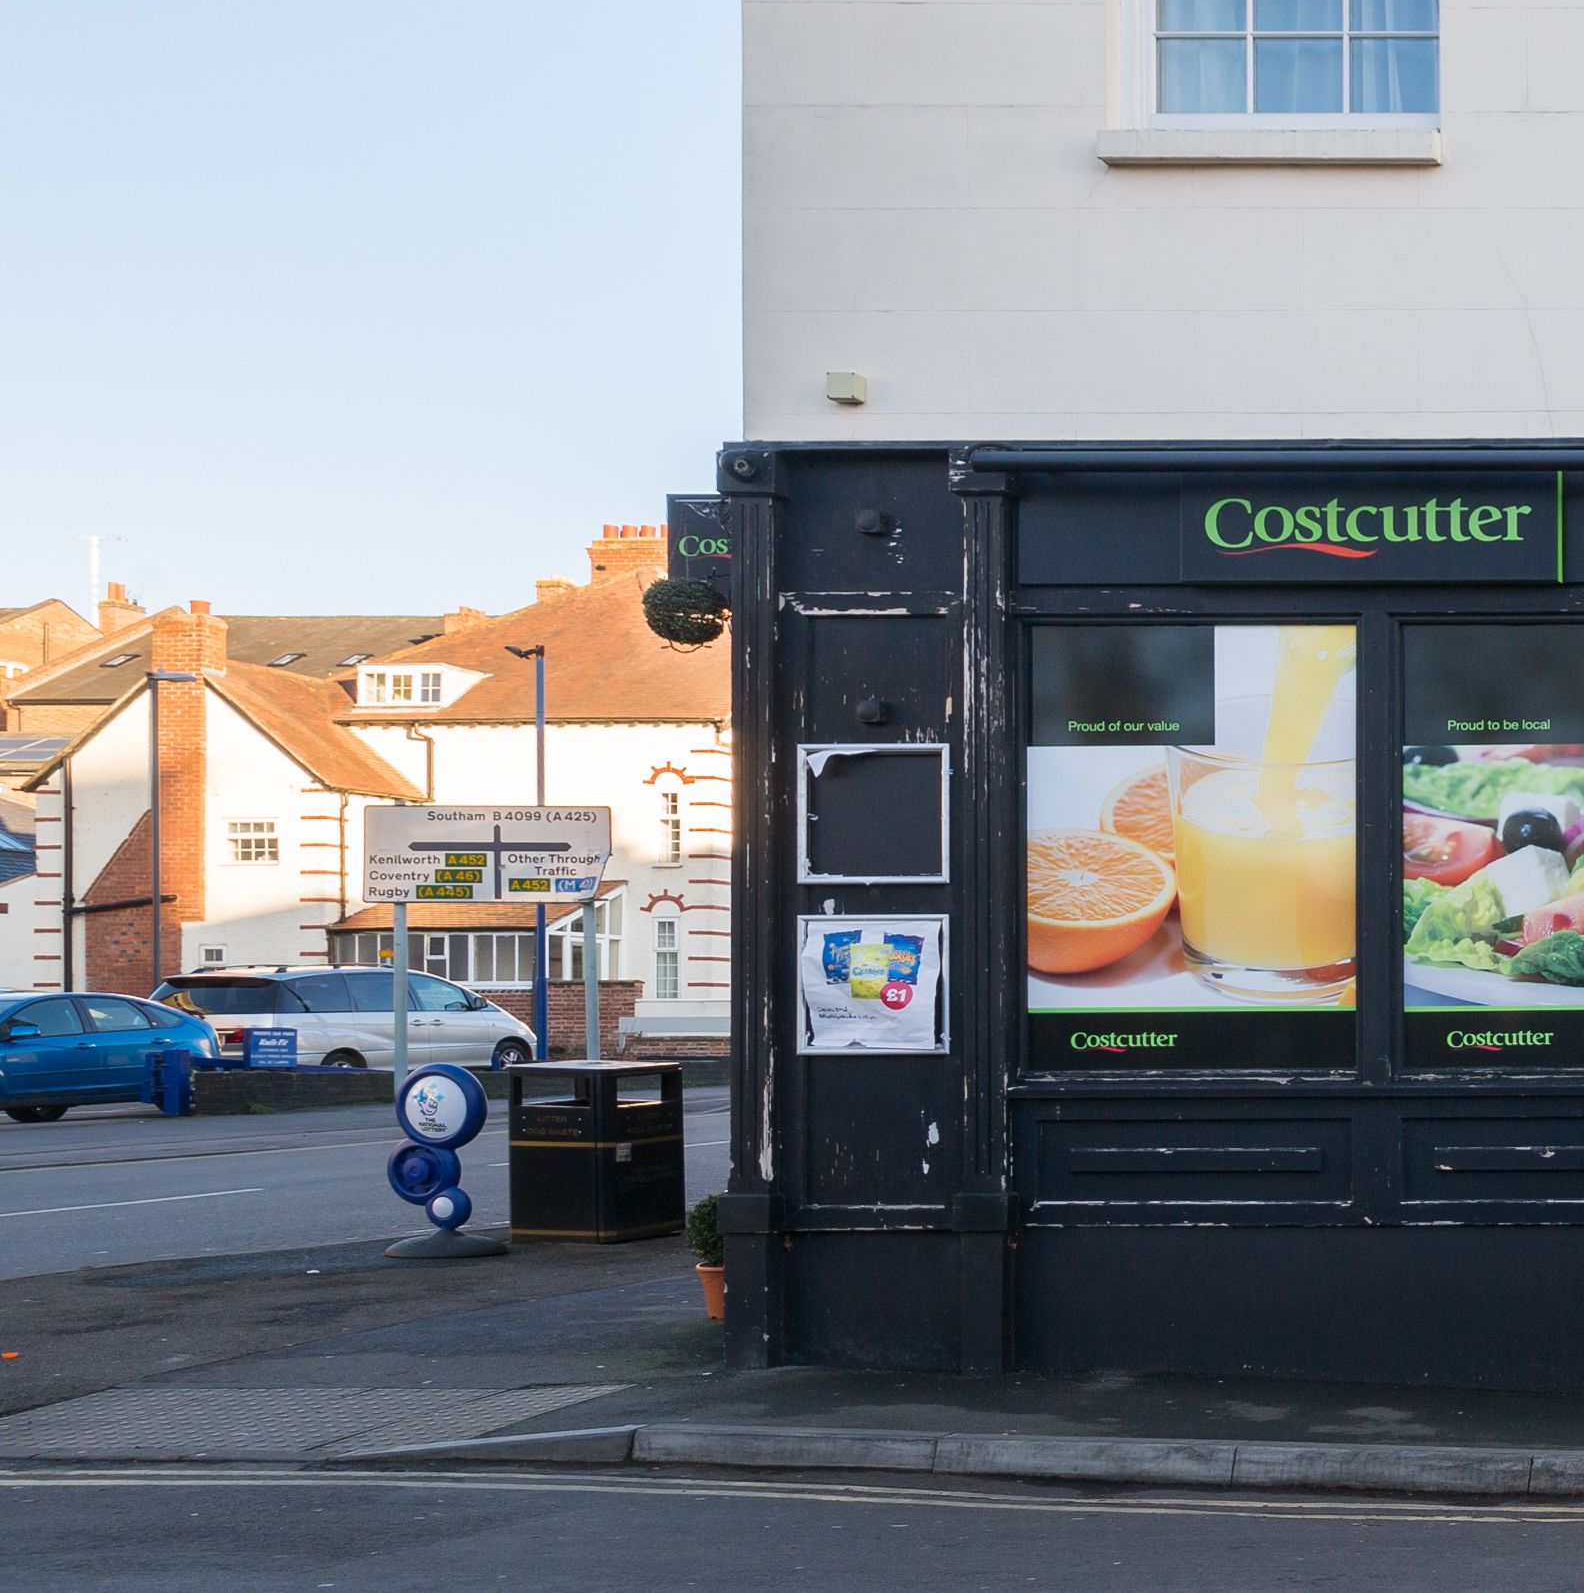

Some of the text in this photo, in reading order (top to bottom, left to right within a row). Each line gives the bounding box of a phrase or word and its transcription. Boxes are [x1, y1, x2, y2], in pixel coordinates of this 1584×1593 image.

[1204, 497, 1532, 549] Costcutter
[679, 535, 729, 557] Cos
[1068, 721, 1180, 731] Proud of our value
[1447, 719, 1551, 731] Proud to be local
[427, 811, 486, 821] Southam
[369, 854, 441, 865] Kenilworth
[508, 854, 601, 865] Other Through
[369, 870, 430, 882] Coventry
[534, 866, 577, 876] Traffic
[368, 886, 410, 898] Rugby
[886, 988, 907, 1002] £1
[1070, 1031, 1178, 1050] Costcutter
[1447, 1030, 1554, 1048] Costcutter
